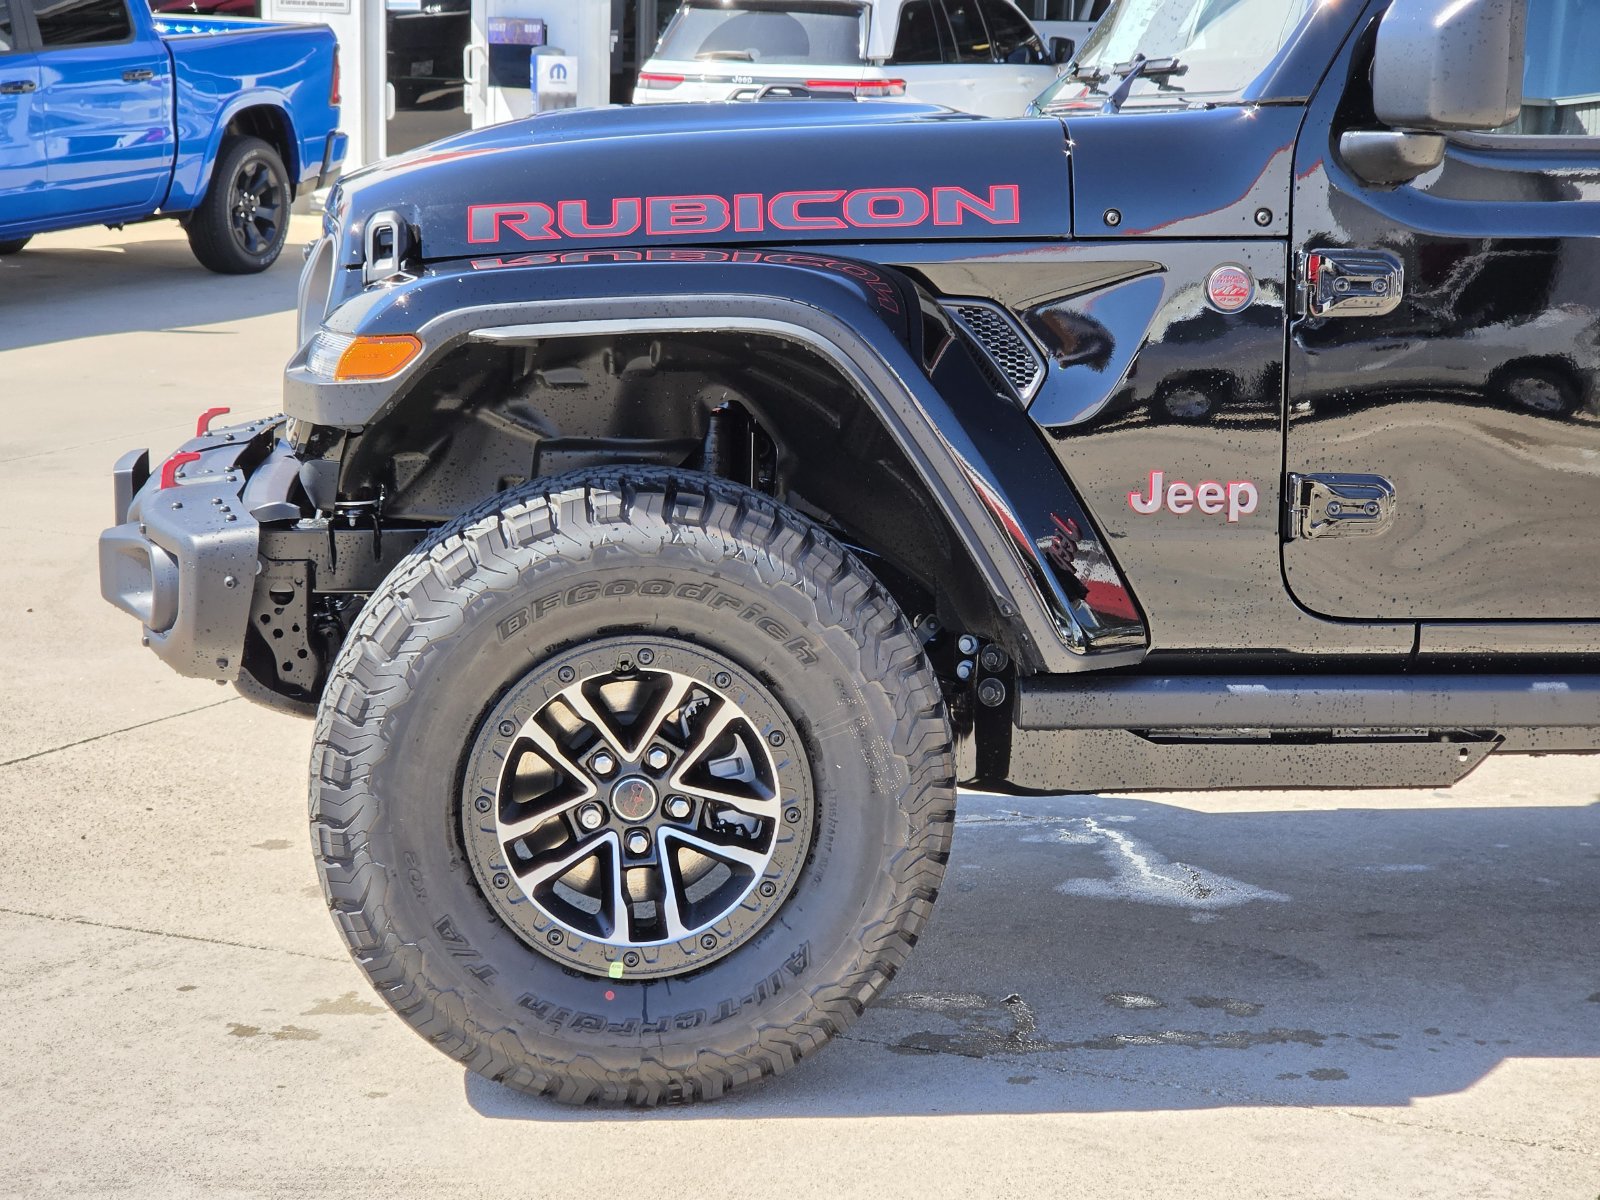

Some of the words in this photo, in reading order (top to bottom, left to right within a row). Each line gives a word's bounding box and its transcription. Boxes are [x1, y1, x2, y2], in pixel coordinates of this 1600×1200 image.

[524, 24, 541, 33] DROP
[731, 75, 753, 84] Jeep
[467, 184, 1020, 244] RUBICON
[1128, 470, 1259, 523] Jeep
[496, 579, 819, 667] BFGoodrich
[432, 914, 500, 987] T/A
[517, 939, 811, 1035] All-Terrain
